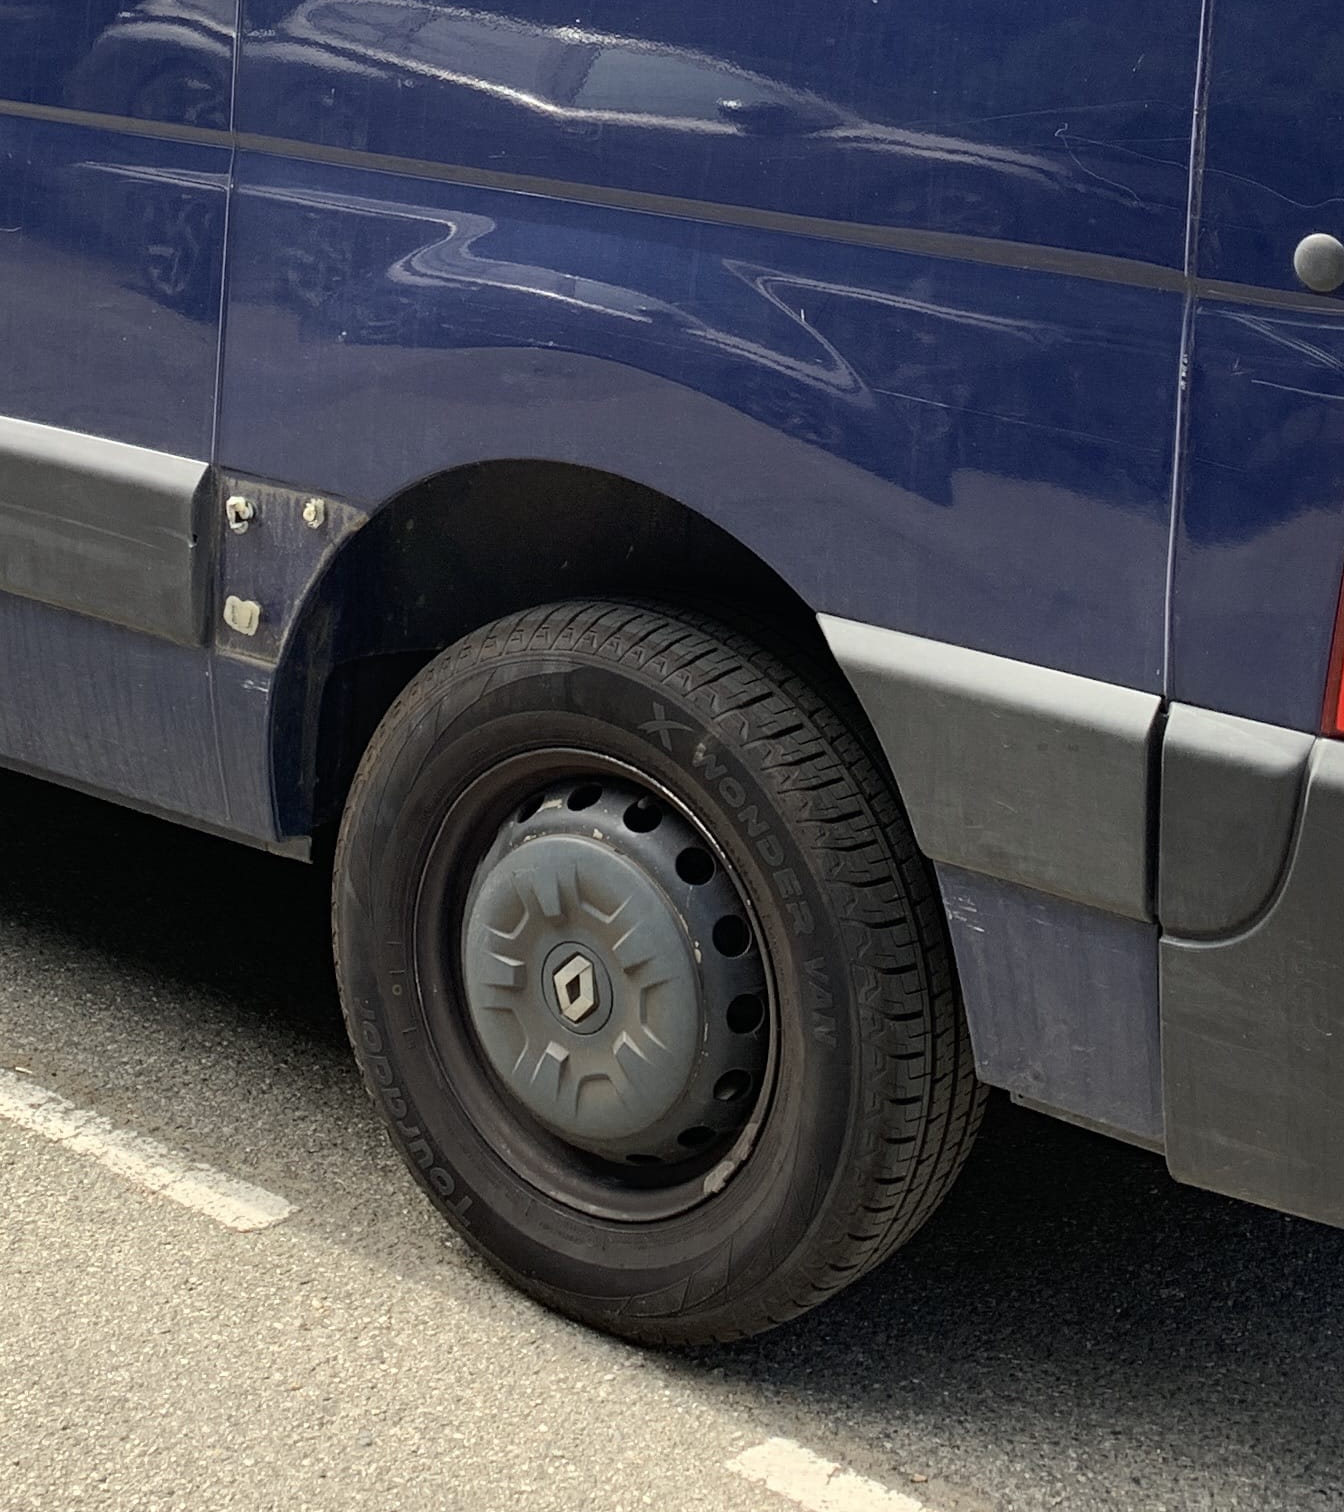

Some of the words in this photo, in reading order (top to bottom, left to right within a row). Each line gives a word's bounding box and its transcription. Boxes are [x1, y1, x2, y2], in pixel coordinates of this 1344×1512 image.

[636, 701, 695, 752] X
[691, 742, 817, 937] WONDER
[801, 956, 838, 1049] VAN
